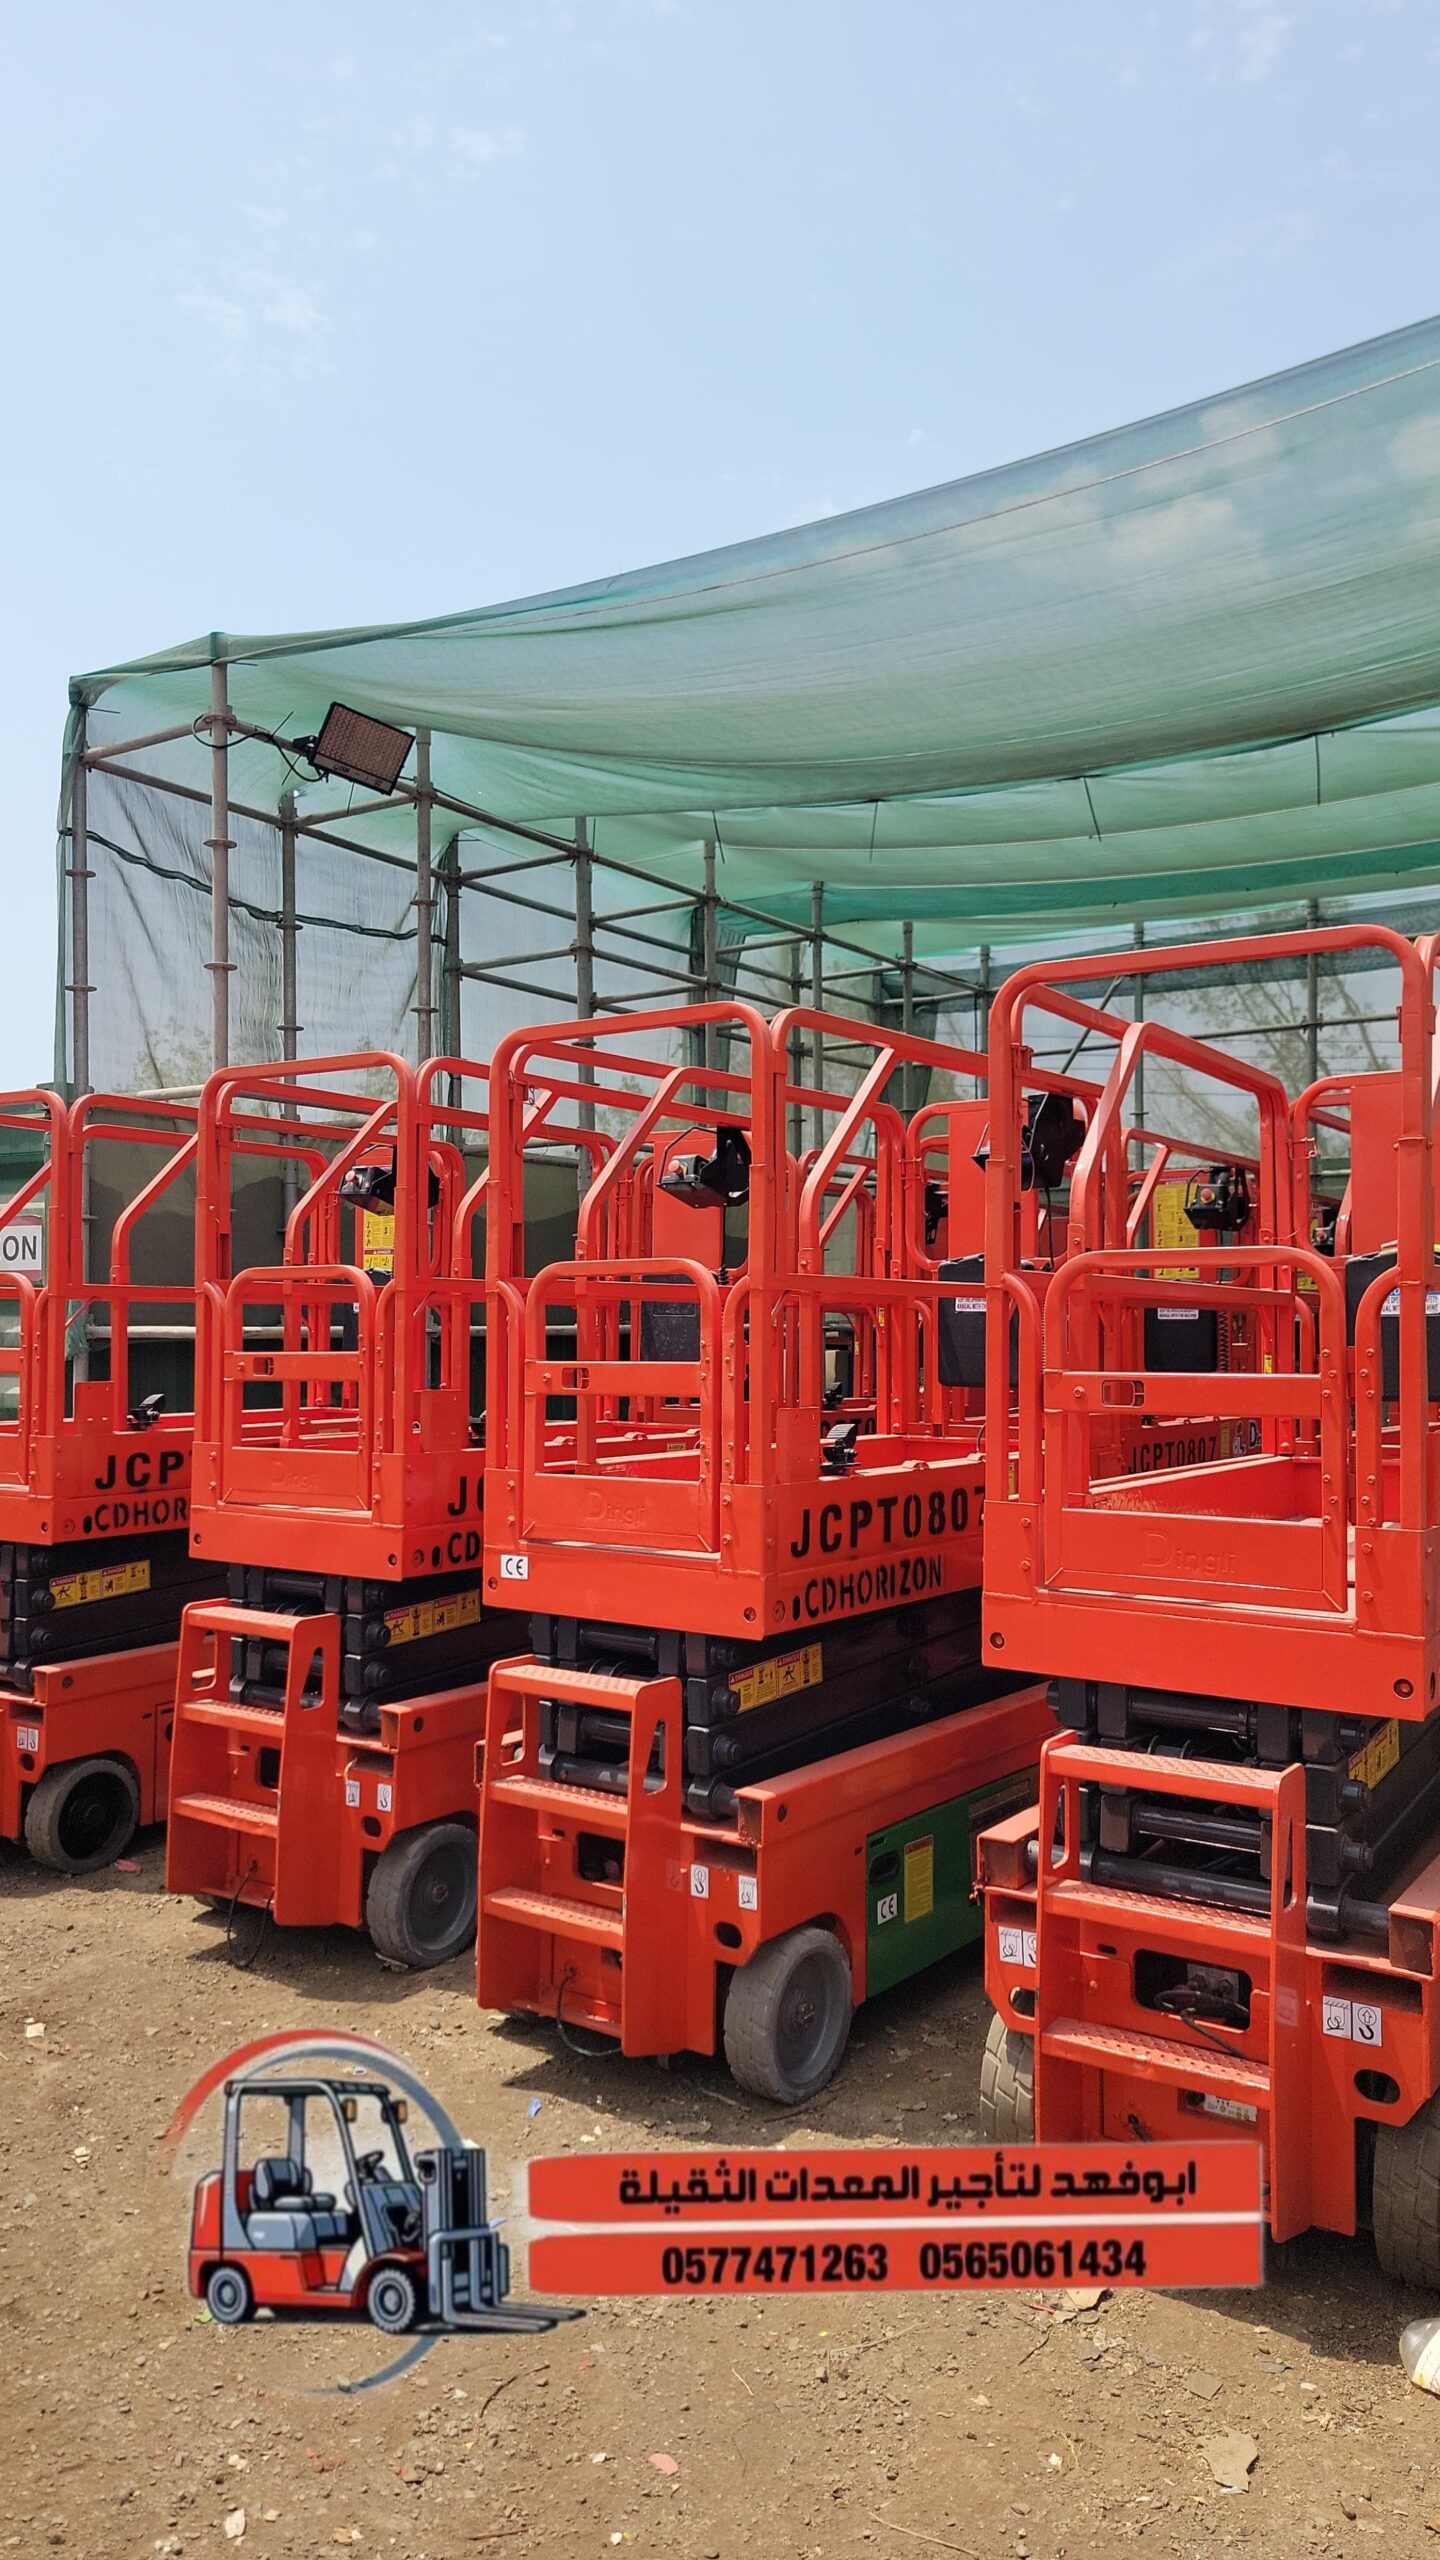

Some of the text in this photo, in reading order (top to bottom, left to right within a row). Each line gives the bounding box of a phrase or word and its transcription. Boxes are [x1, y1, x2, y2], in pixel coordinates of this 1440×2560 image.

[2, 1235, 37, 1261] ON
[95, 1451, 192, 1489] JCP
[1128, 1436, 1227, 1474] JCPT0807
[505, 1557, 524, 1576] CE
[1141, 1528, 1237, 1576] Dingli
[805, 1554, 942, 1618] CDHORIZON
[880, 1897, 895, 1919] CE
